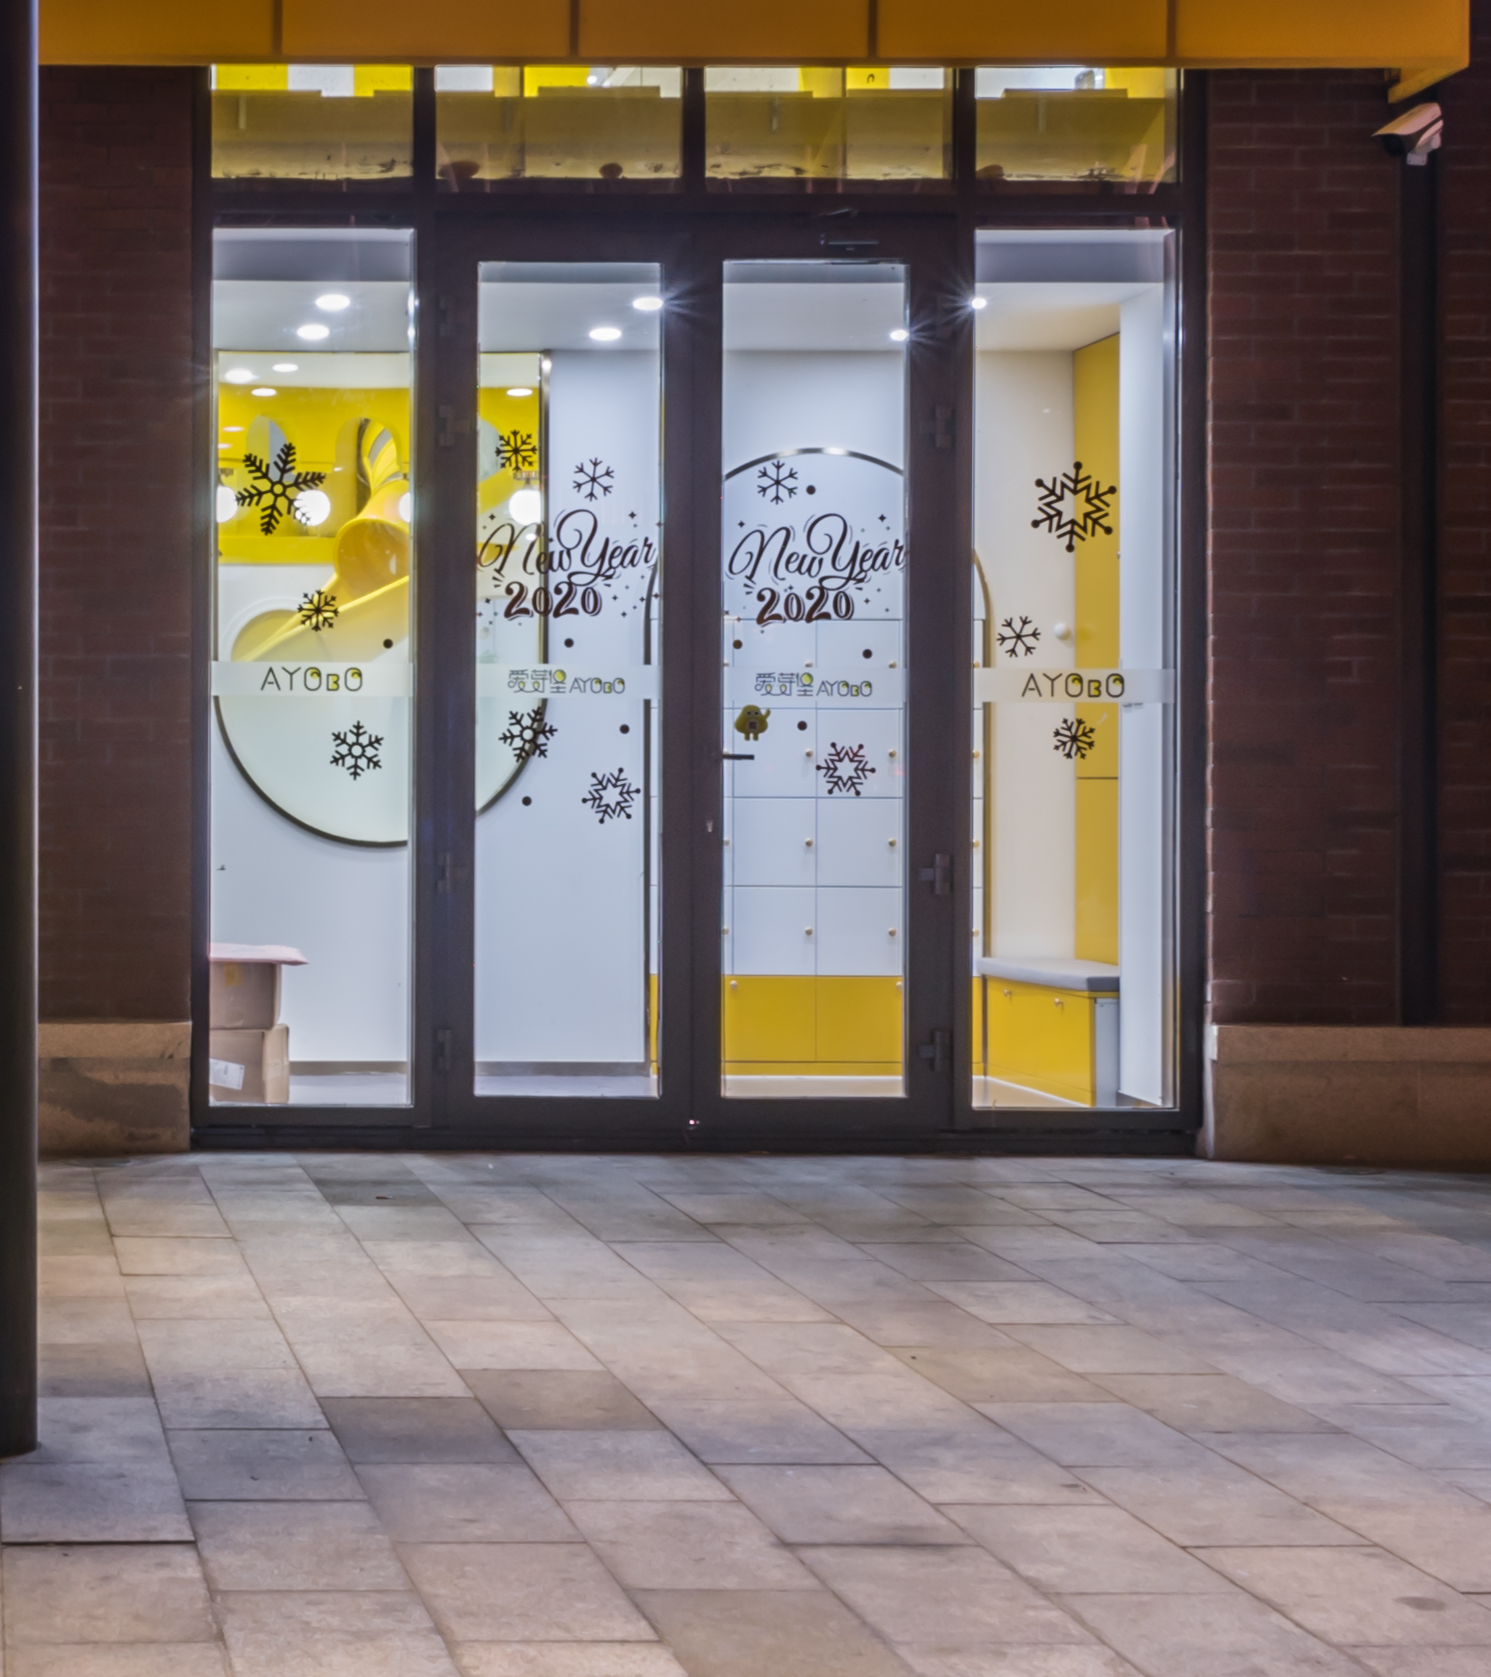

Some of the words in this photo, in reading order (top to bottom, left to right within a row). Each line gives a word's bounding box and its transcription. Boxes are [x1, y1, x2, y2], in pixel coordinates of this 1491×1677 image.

[476, 522, 570, 576] New
[555, 509, 657, 587] Year
[728, 526, 824, 579] New
[805, 513, 908, 593] Year
[503, 580, 603, 621] 2020
[755, 585, 855, 627] 2020
[260, 666, 363, 691] AYOBO
[1021, 672, 1125, 698] AYOBO
